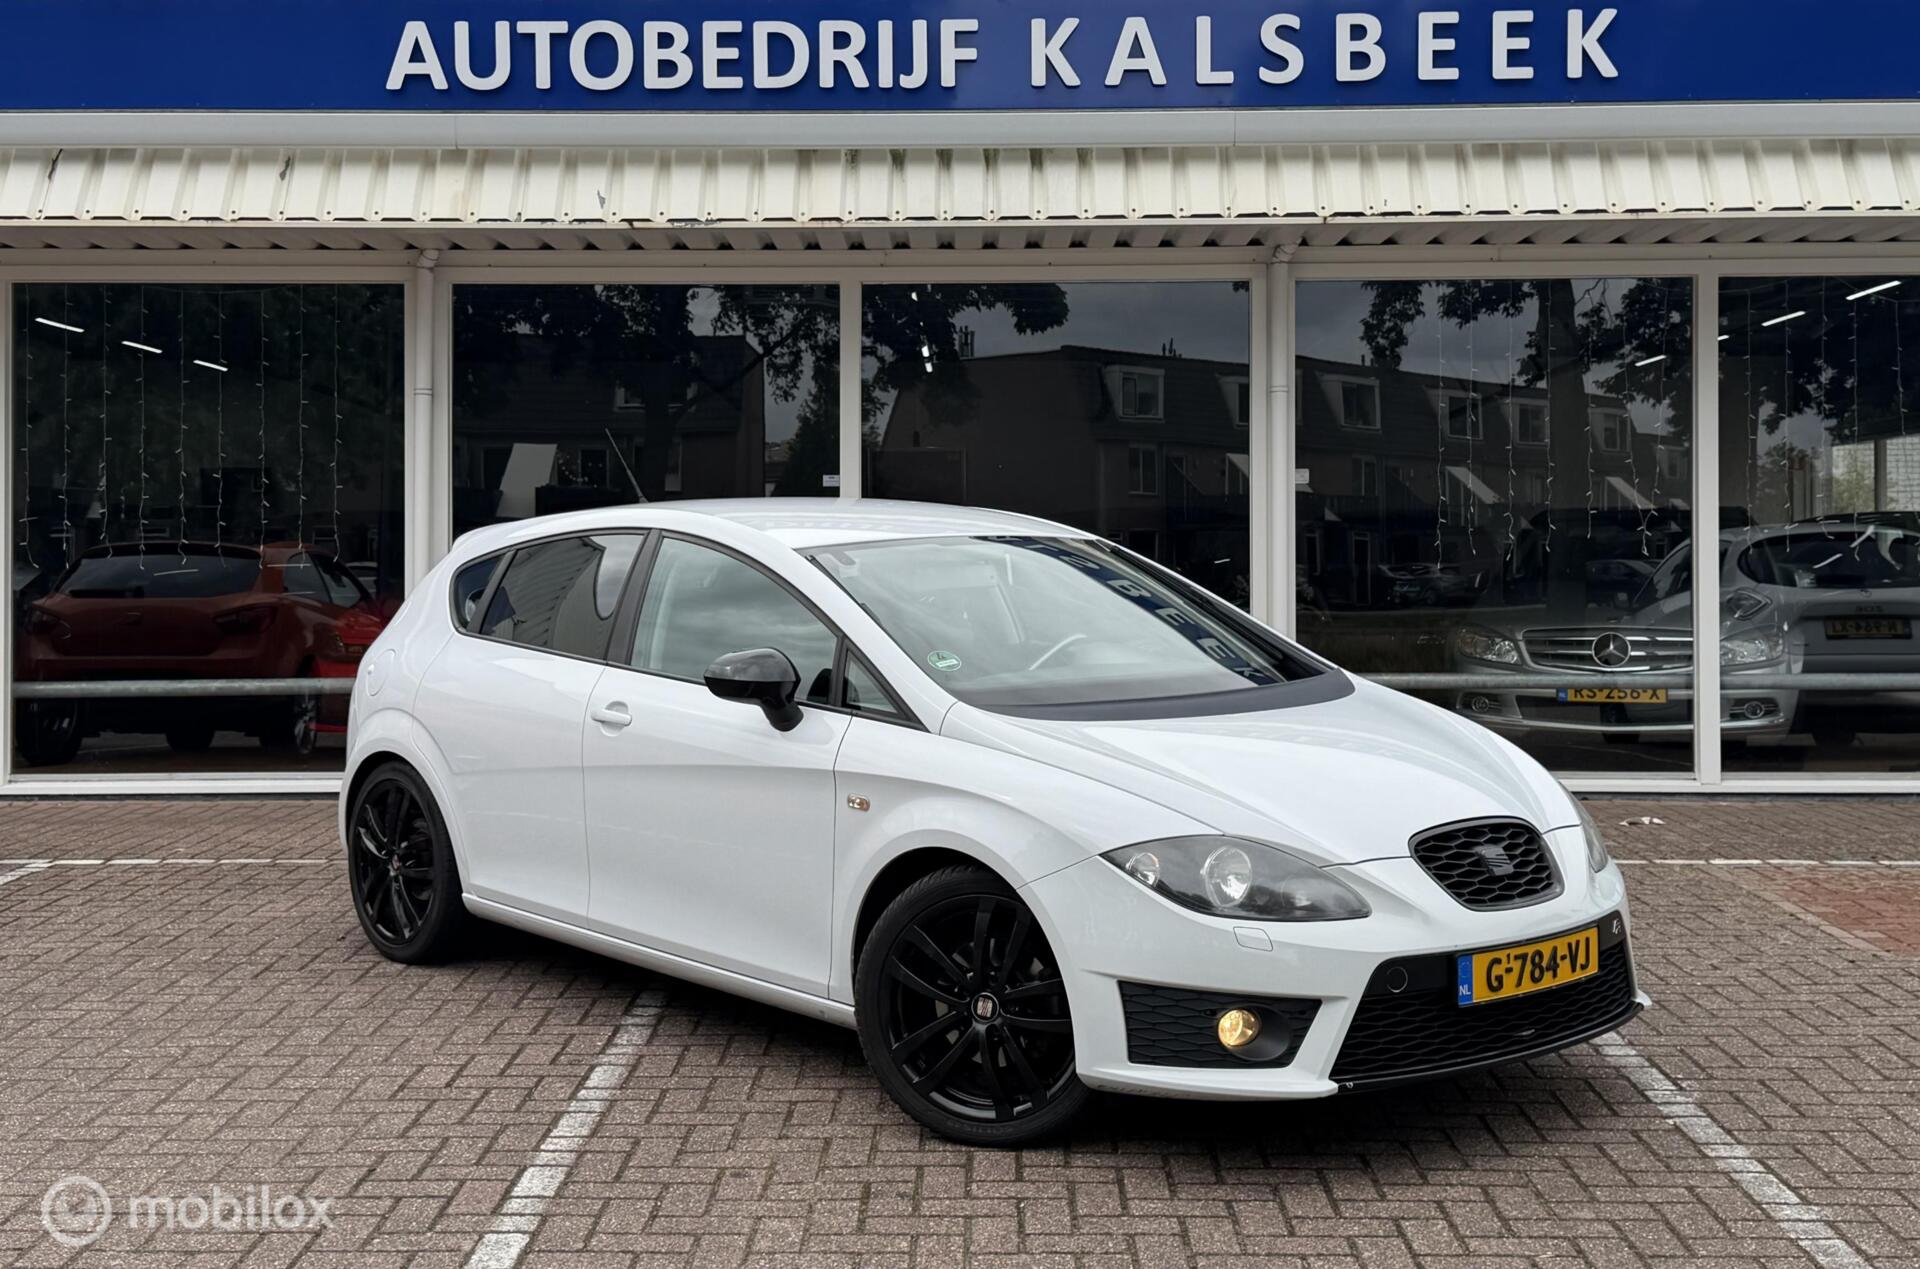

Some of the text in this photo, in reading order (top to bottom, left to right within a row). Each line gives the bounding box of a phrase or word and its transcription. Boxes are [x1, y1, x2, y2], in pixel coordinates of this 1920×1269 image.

[385, 8, 1619, 91] AUTOBEDRIJF KALSBEEK
[1459, 984, 1471, 996] NL
